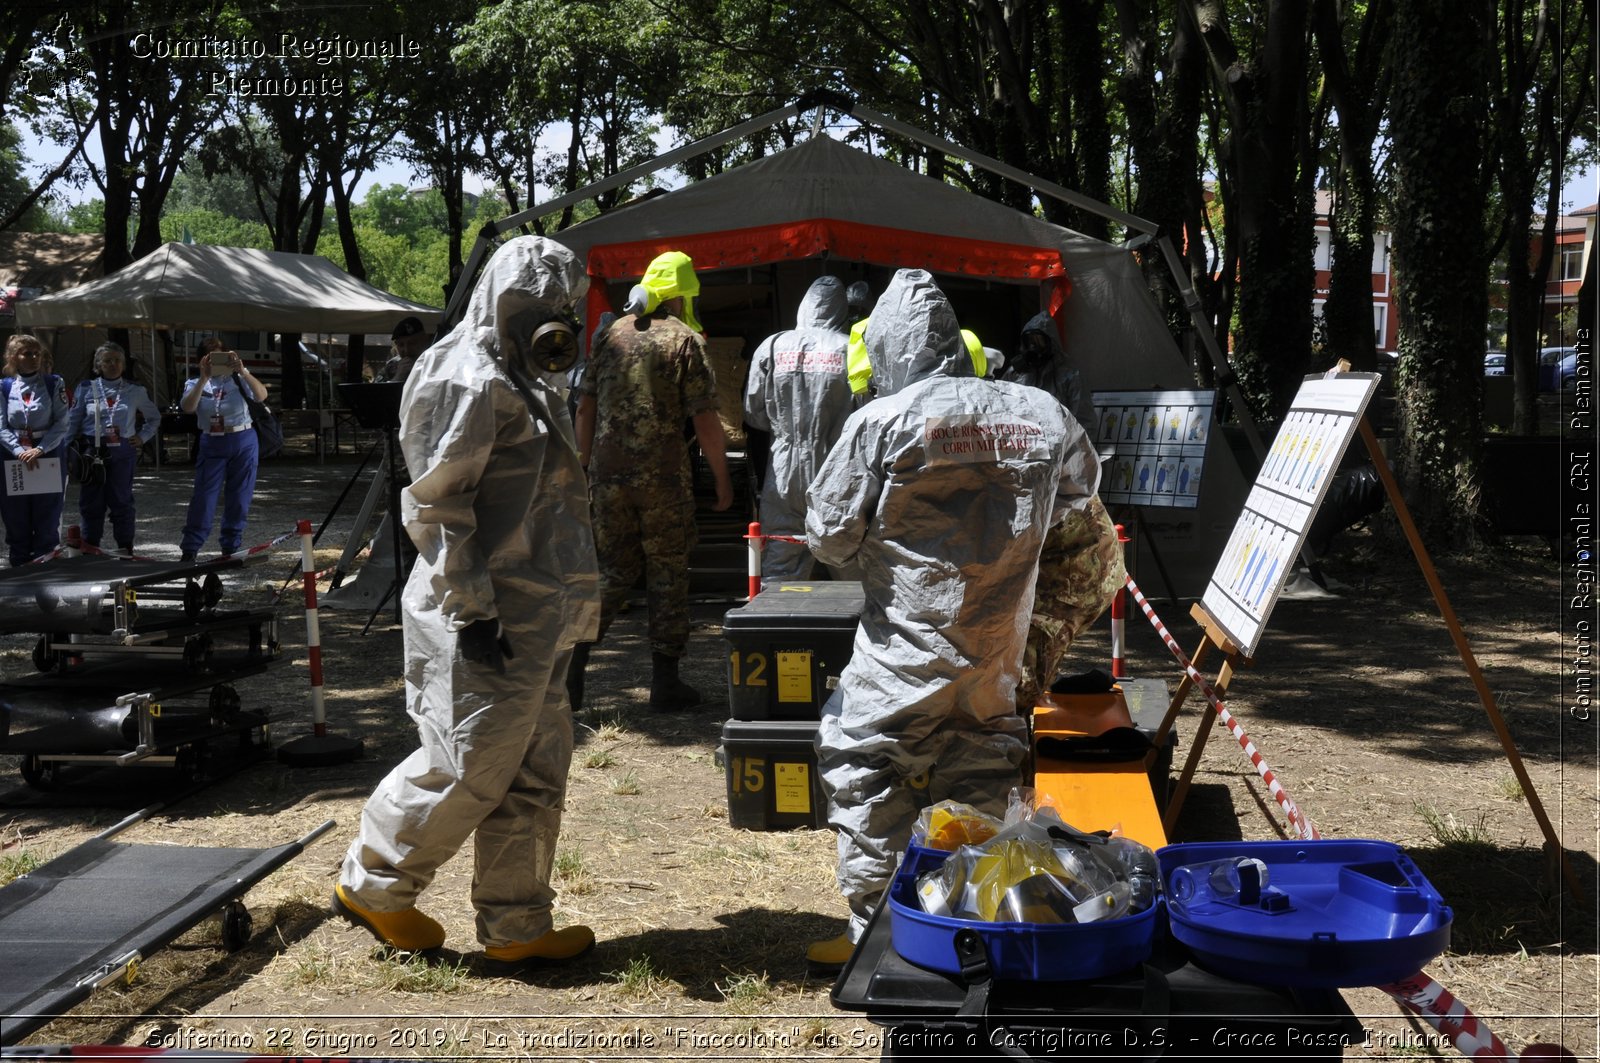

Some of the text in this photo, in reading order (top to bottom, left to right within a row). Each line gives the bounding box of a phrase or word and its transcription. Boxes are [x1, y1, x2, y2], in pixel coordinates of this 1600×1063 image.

[925, 426, 960, 441] CROCE
[942, 441, 974, 455] CORPO
[730, 651, 768, 686] 12
[731, 757, 766, 793] 15
